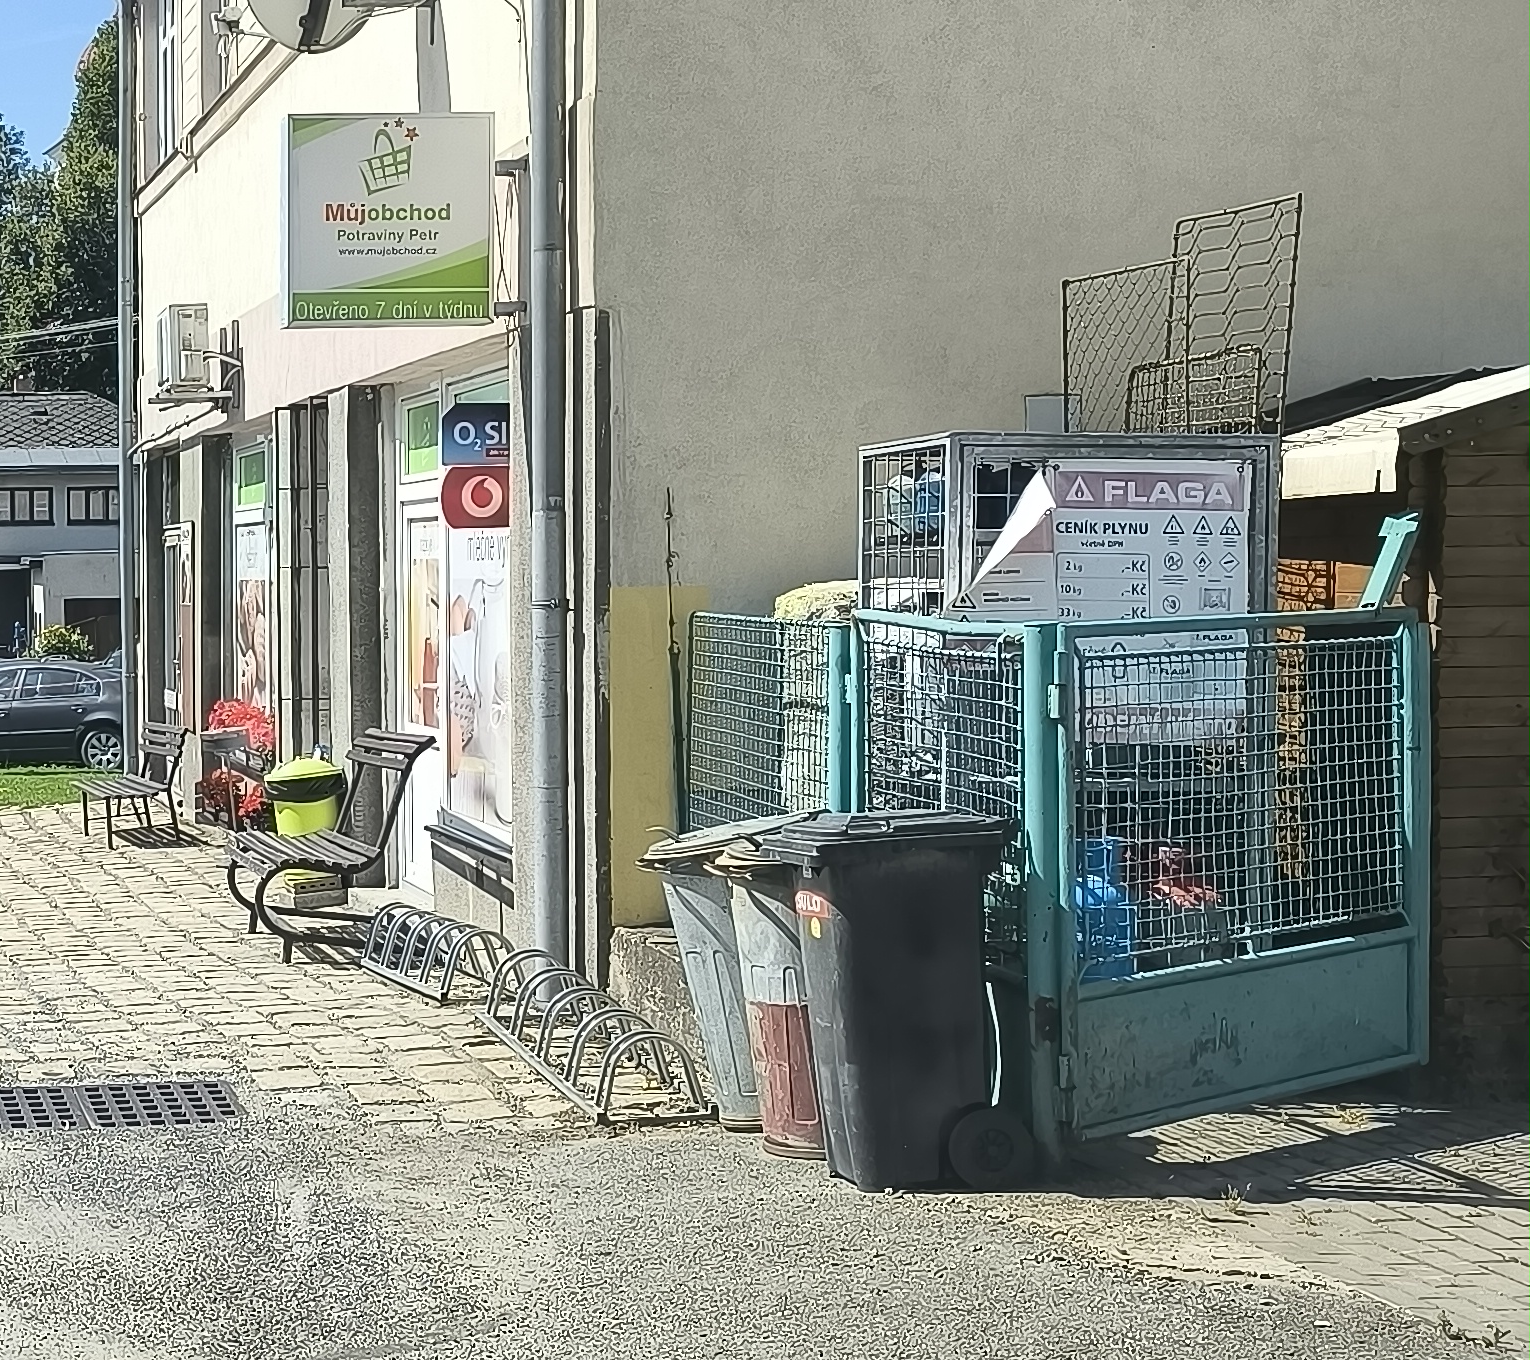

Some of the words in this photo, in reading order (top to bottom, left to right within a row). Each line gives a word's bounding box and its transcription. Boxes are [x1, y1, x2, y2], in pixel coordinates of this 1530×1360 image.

[325, 202, 451, 225] Můjobchod
[337, 229, 405, 244] Potraviny
[409, 229, 439, 242] Petr
[338, 246, 438, 257] www.mujobchod.cz
[296, 300, 369, 320] Otevřeno
[375, 301, 386, 318] 7
[392, 300, 418, 318] dní
[422, 305, 433, 318] v
[438, 300, 484, 320] týdnu
[453, 421, 482, 451] O2
[1104, 480, 1232, 505] FLAGA
[1056, 519, 1099, 535] CENÍK
[1103, 522, 1149, 535] PLYNU
[1065, 561, 1071, 571] 2
[1060, 584, 1072, 595] 10
[1058, 607, 1072, 618] 33
